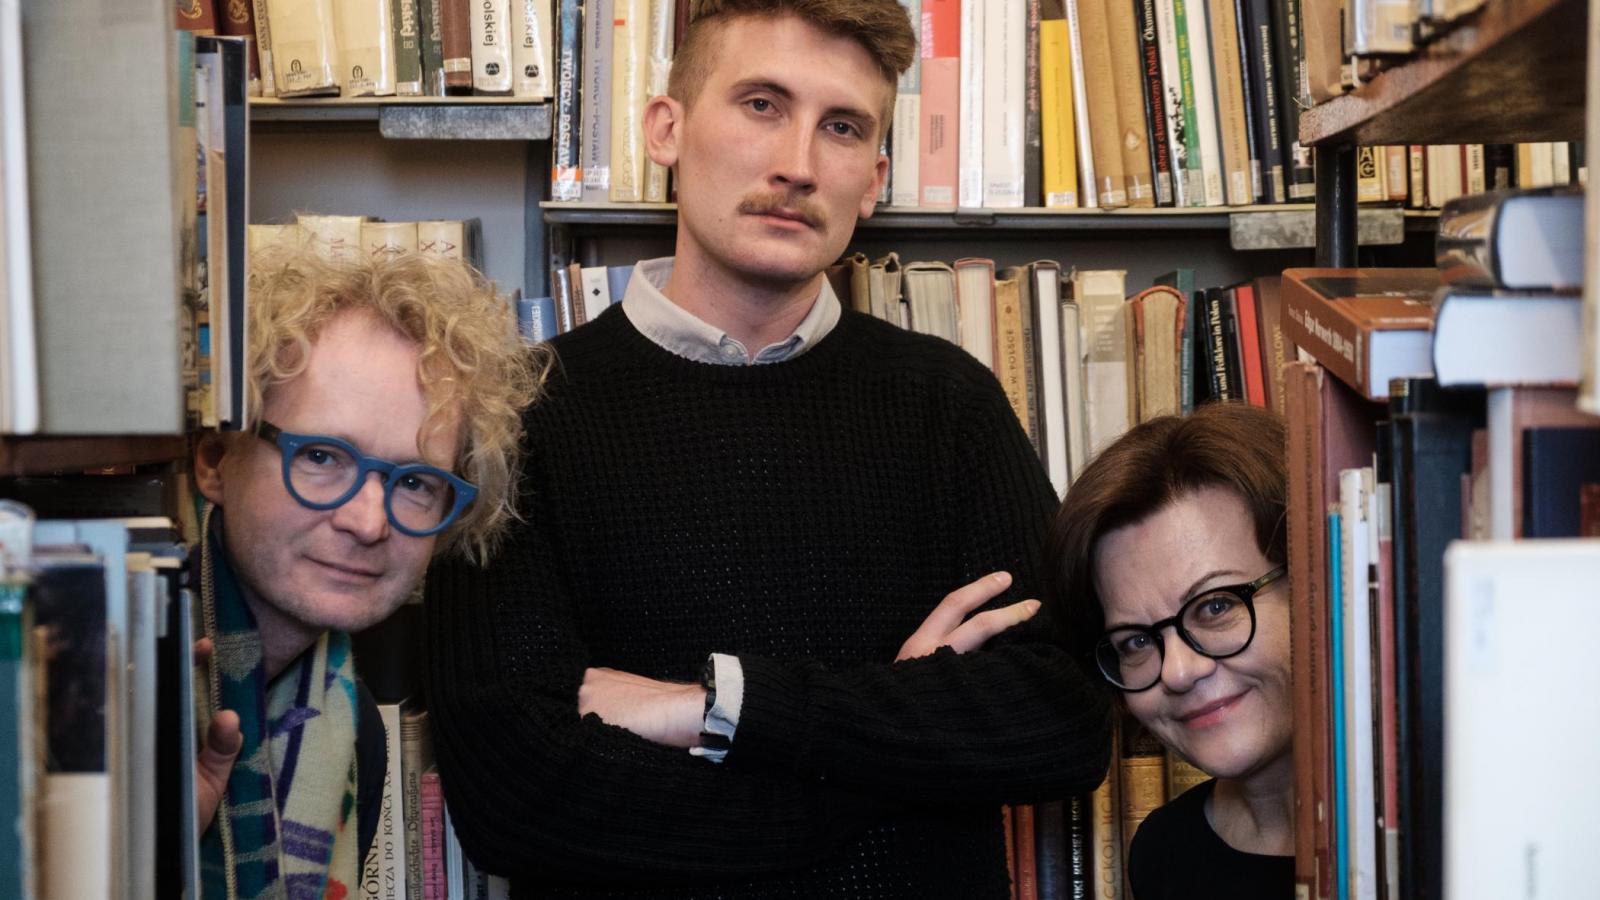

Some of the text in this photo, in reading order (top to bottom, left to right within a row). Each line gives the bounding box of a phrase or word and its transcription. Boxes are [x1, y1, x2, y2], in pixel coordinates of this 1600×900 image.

[1146, 45, 1159, 76] Polski
[1151, 79, 1166, 142] ekumeniczny
[1210, 300, 1221, 324] Polen
[1212, 325, 1222, 335] in
[1006, 328, 1016, 370] POLSCE
[1213, 336, 1226, 371] Folklore
[1217, 373, 1228, 390] und
[382, 792, 393, 836] KOŃCA
[385, 841, 394, 860] DO
